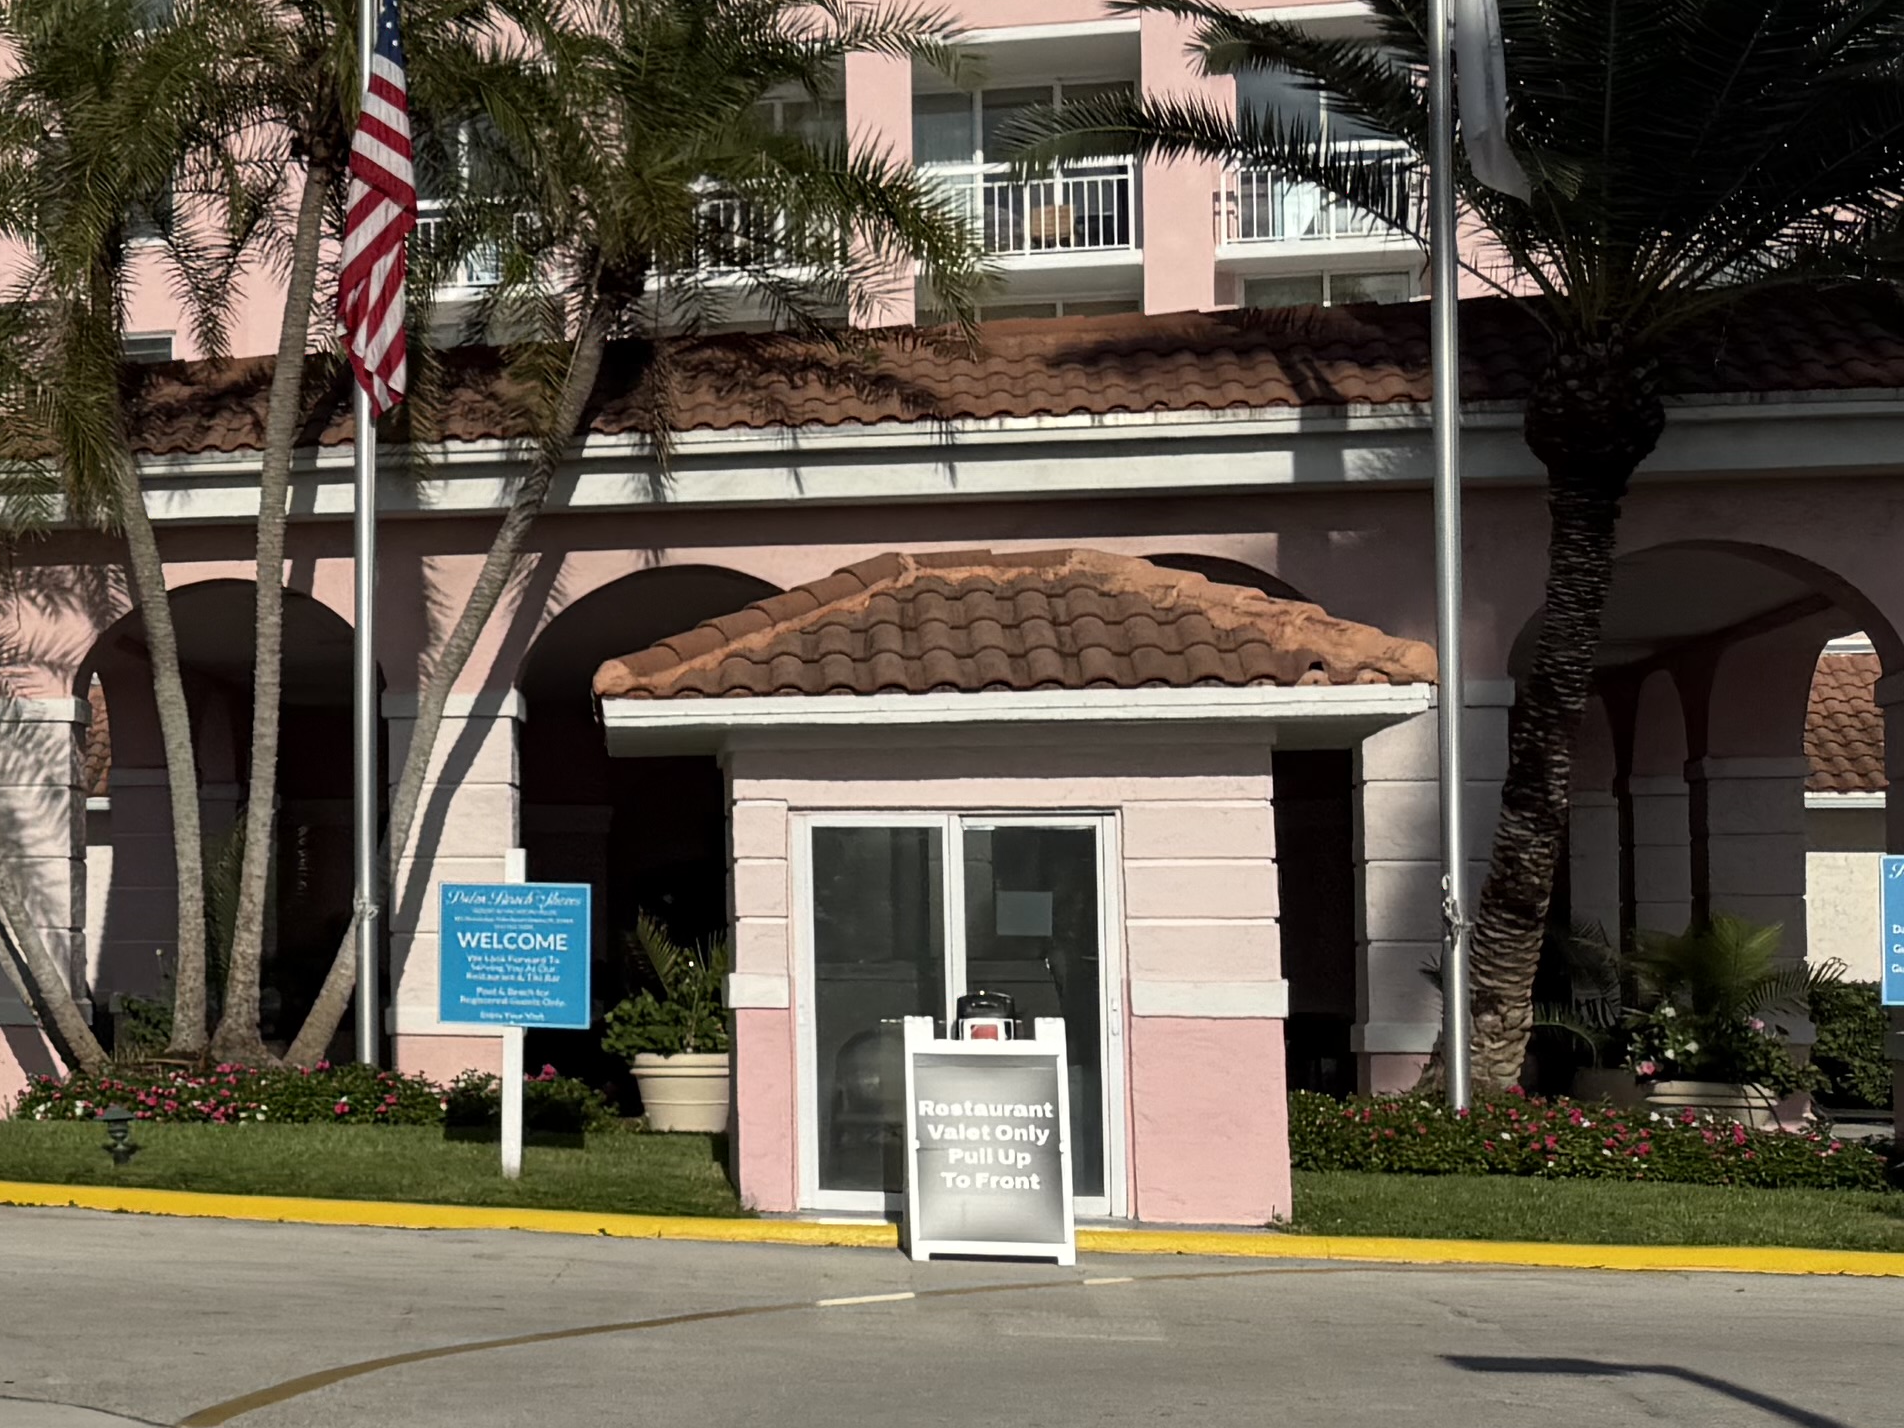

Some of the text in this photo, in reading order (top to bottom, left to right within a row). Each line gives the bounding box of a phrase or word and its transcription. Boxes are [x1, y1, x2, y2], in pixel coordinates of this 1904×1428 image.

[446, 889, 582, 911] Palm Beach Shores
[457, 932, 568, 951] WELCOME
[508, 955, 546, 964] Forward
[549, 956, 560, 964] To
[466, 972, 514, 982] Restaurant
[544, 974, 560, 982] Bar
[527, 965, 536, 973] At
[476, 987, 496, 995] Pool
[460, 996, 508, 1006] Registered
[918, 1100, 1054, 1118] Restaurant
[928, 1124, 1050, 1146] Valet Only
[949, 1148, 1032, 1169] Pull Up
[941, 1172, 1041, 1190] To Front
